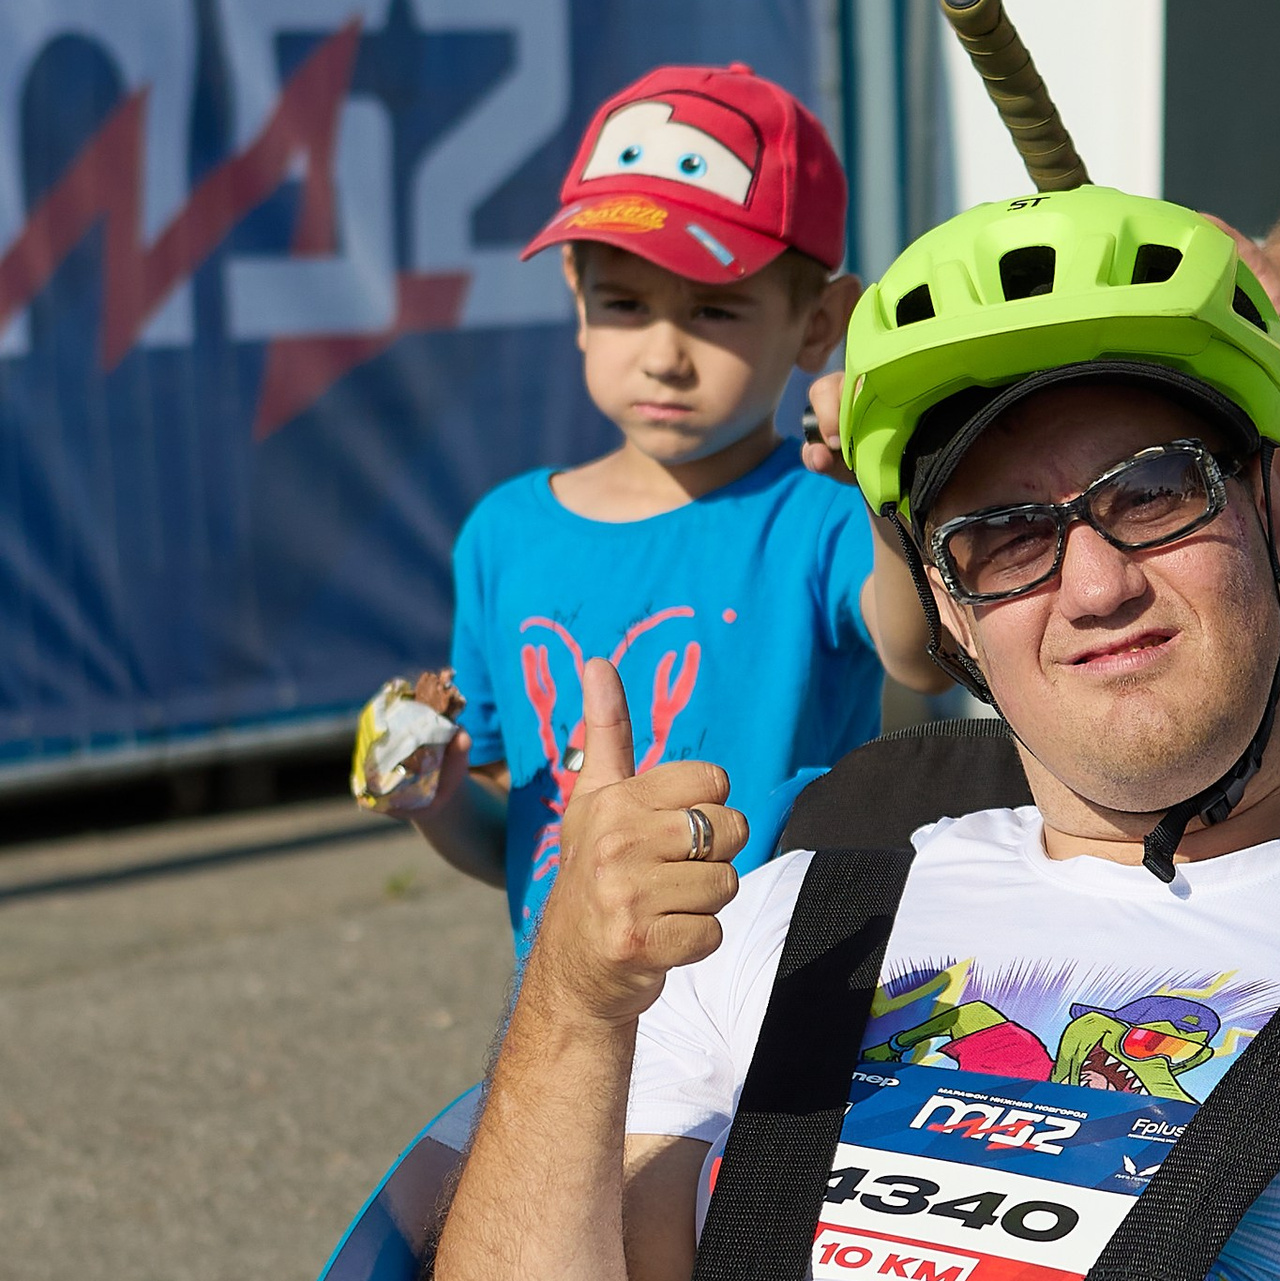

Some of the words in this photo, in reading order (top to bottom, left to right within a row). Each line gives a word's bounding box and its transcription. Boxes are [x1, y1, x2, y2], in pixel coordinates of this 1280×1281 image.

[938, 1087, 988, 1101] МАРАФОН
[990, 1096, 1033, 1109] НИЖНИЙ
[1034, 1104, 1088, 1120] НОВГОРОД
[1131, 1118, 1187, 1138] Fplus
[823, 1166, 1080, 1243] 4340
[819, 1241, 873, 1269] 10
